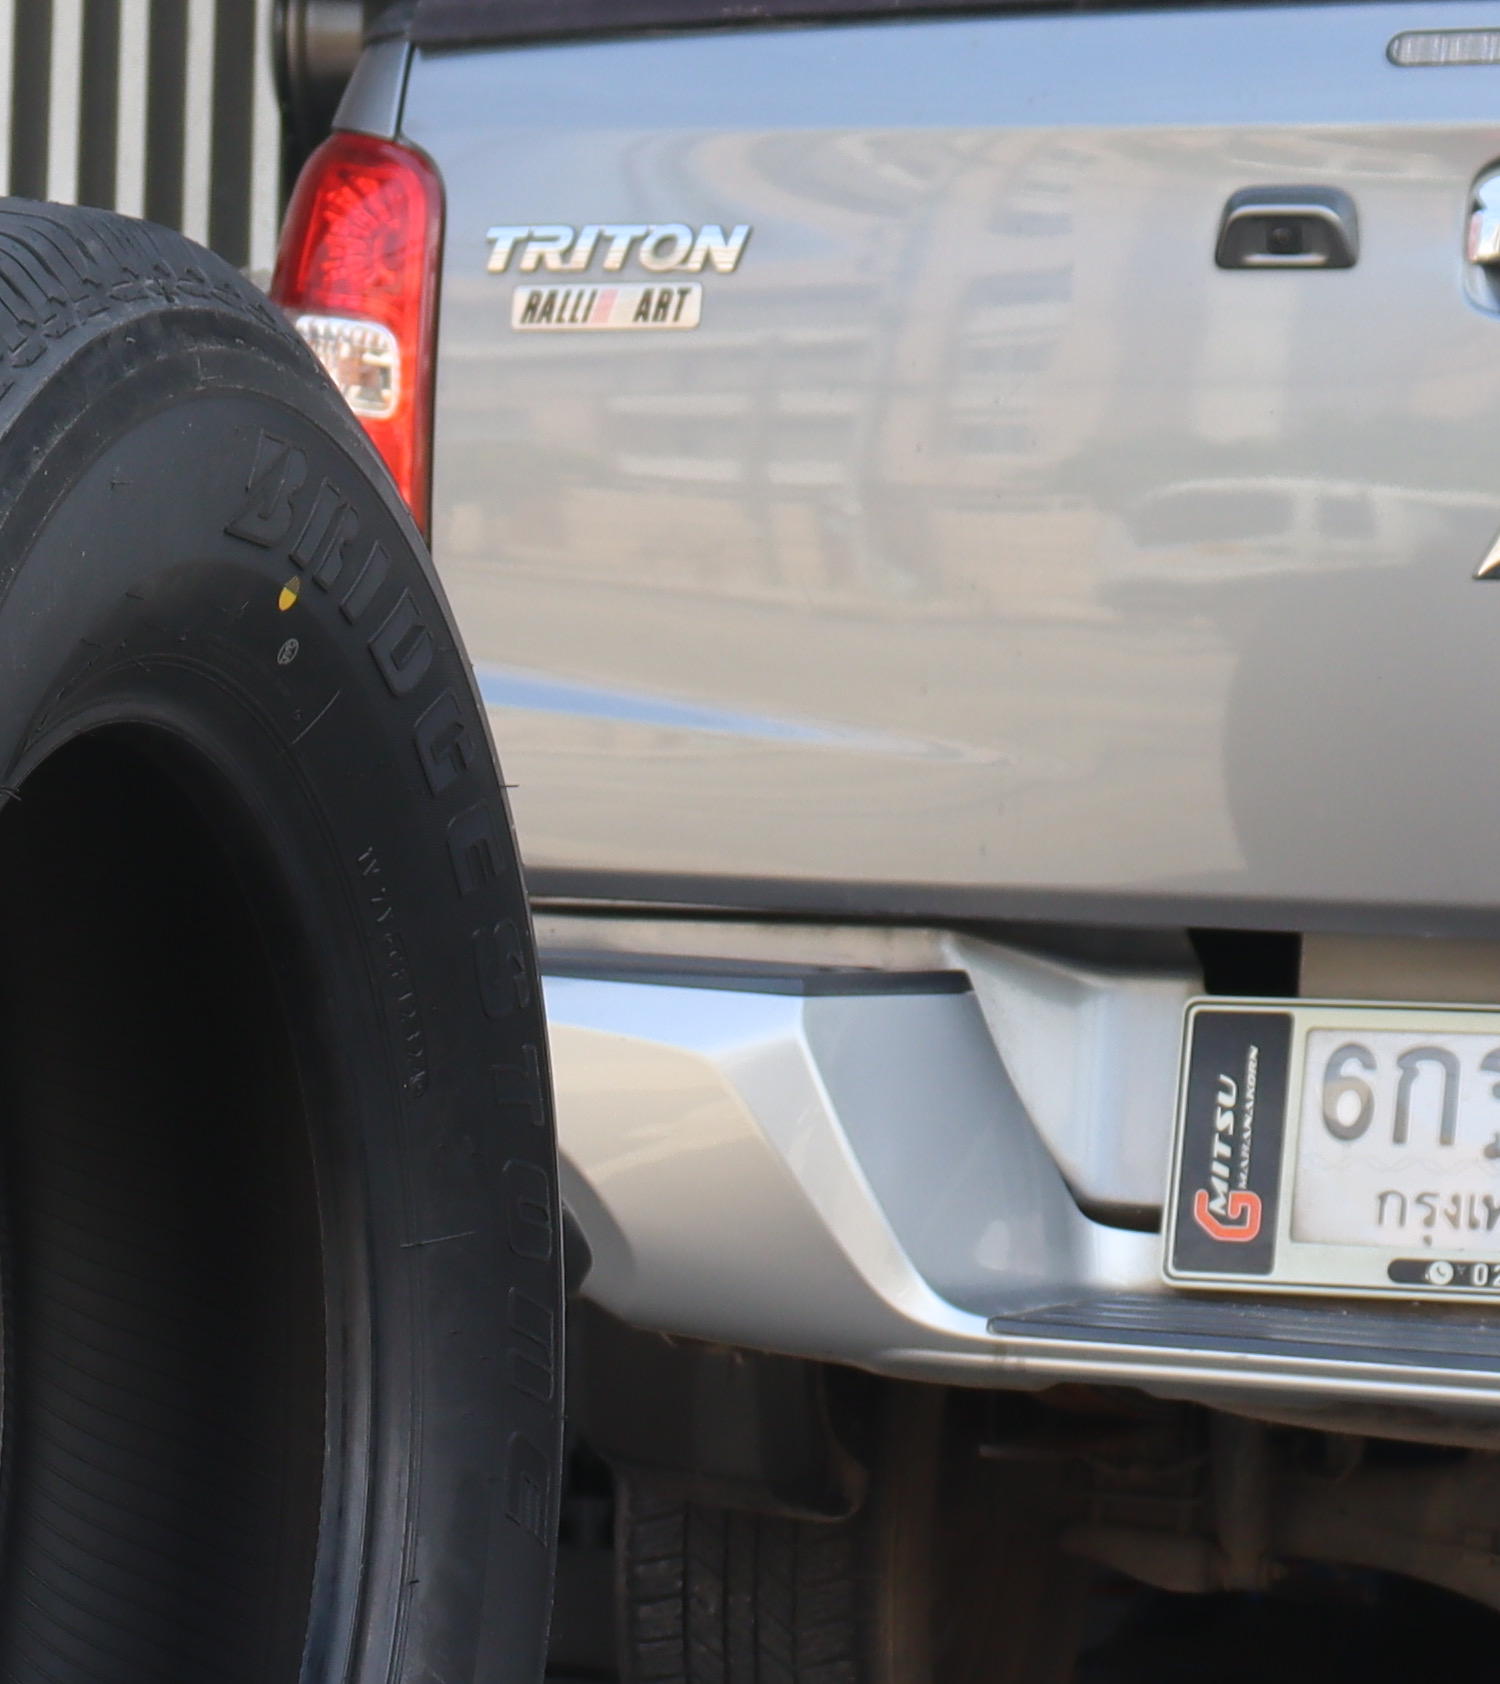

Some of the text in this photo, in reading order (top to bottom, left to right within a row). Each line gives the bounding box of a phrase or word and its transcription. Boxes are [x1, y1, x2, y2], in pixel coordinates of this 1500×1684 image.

[486, 223, 752, 273] TRITON
[520, 287, 692, 324] RALLI ART
[1208, 1073, 1238, 1215] MITSU
[1238, 1044, 1259, 1190] MAHANAKORN
